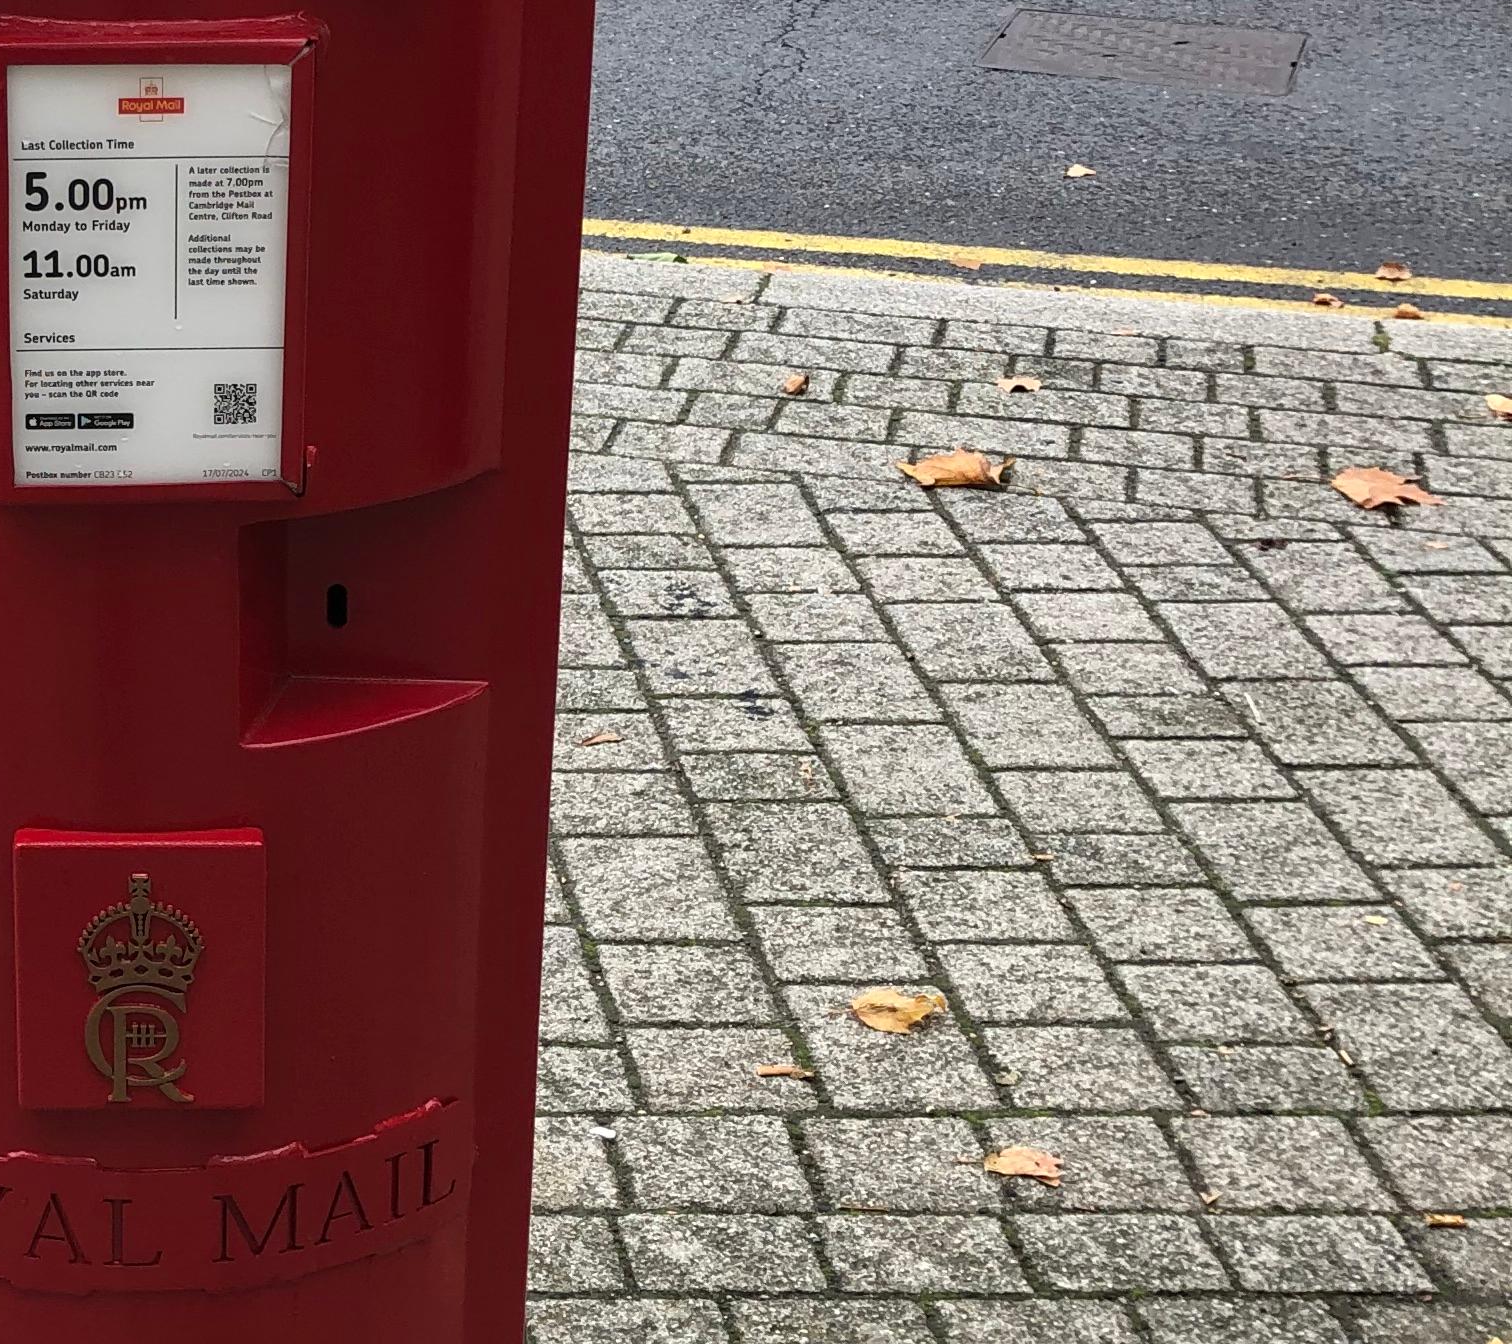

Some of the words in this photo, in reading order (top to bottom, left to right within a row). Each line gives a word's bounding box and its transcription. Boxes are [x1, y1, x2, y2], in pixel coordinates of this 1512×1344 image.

[121, 100, 154, 112] Royal
[155, 99, 181, 110] Mail
[21, 139, 46, 150] Last
[48, 139, 103, 150] Collection
[105, 139, 135, 150] Time
[188, 166, 195, 174] A
[197, 166, 218, 174] later
[219, 166, 260, 174] collection
[262, 166, 270, 174] is
[188, 179, 212, 187] made
[226, 177, 264, 189] 7.00pm
[24, 171, 147, 214] 5.00pm
[188, 190, 209, 199] from
[212, 190, 226, 198] the
[228, 190, 261, 198] Postbox
[264, 190, 273, 198] at
[188, 201, 234, 210] Cambridge
[236, 201, 255, 209] Mail
[188, 213, 219, 221] Centre,
[221, 212, 249, 220] Clifton
[251, 212, 273, 220] Road
[22, 221, 71, 234] Monday
[75, 221, 87, 232] to
[92, 219, 131, 233] Friday
[187, 234, 231, 242] Additional
[234, 246, 253, 254] may
[255, 245, 266, 253] be
[22, 249, 136, 279] 11.00am
[188, 256, 211, 264] made
[214, 256, 262, 265] throughout
[188, 267, 202, 275] the
[204, 267, 220, 276] day
[244, 267, 258, 275] the
[188, 278, 204, 286] last
[206, 278, 226, 286] time
[227, 278, 258, 286] shown.
[23, 288, 79, 301] Saturday
[24, 332, 76, 344] Services
[24, 369, 42, 377] Find
[85, 370, 101, 378] app
[103, 369, 128, 377] store.
[24, 380, 38, 388] For
[40, 380, 74, 389] locating
[75, 379, 98, 387] other
[100, 379, 134, 387] services
[136, 379, 155, 387] near
[24, 392, 40, 400] you
[69, 390, 84, 398] the
[85, 390, 98, 398] QR
[99, 390, 120, 398] code
[39, 419, 54, 428] App
[54, 419, 73, 427] Store
[94, 419, 117, 428] Google
[117, 419, 131, 428] Play
[25, 443, 118, 453] www.royalmail.com
[26, 471, 58, 479] Postbox
[59, 471, 92, 479] number
[93, 471, 115, 479] CB23
[202, 469, 250, 478] 17/07/2024
[261, 468, 277, 477] CP1
[211, 1138, 457, 1263] MAIL
